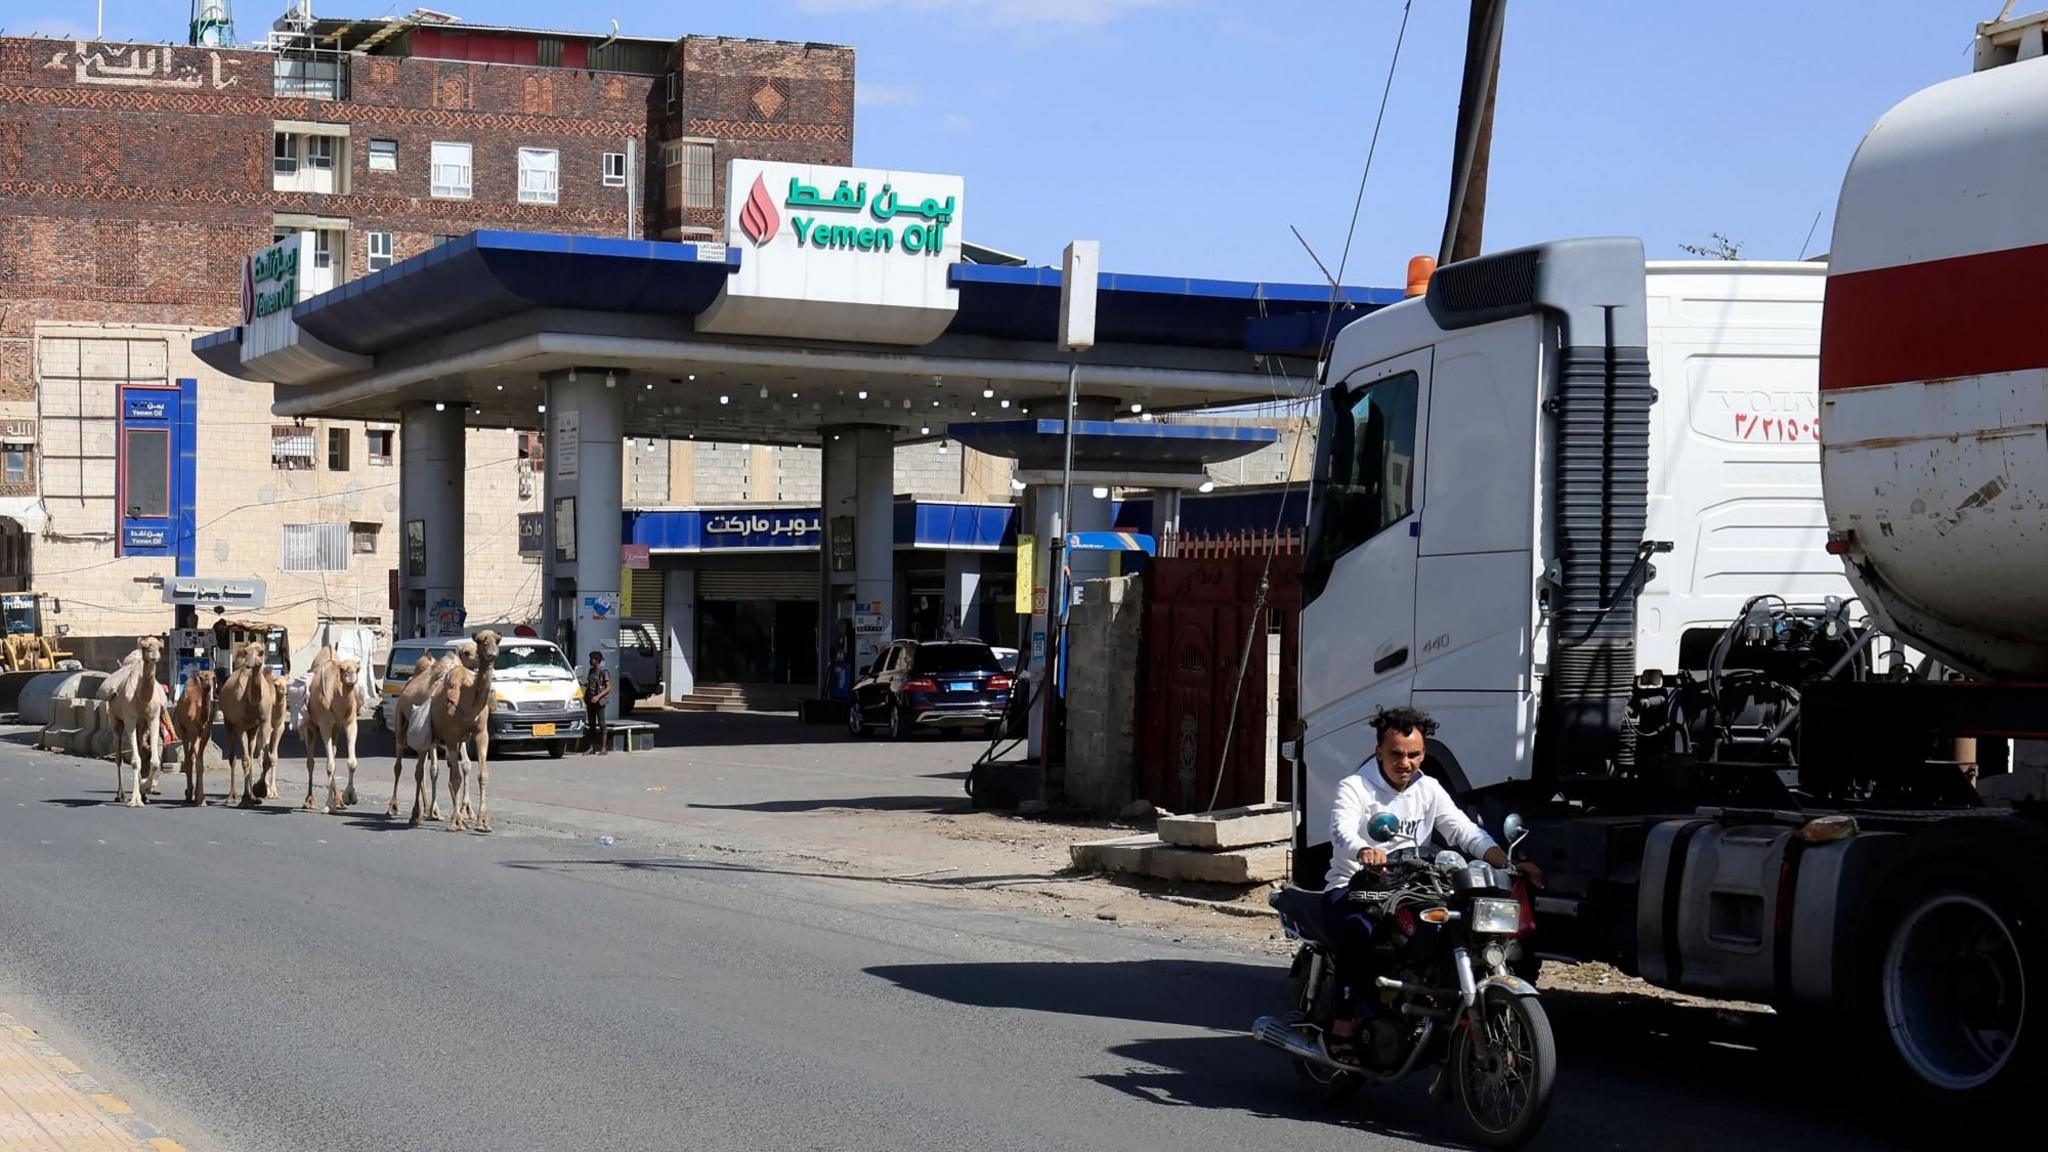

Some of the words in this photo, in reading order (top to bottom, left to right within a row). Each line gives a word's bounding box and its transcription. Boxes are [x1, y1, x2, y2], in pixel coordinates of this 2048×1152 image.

[785, 177, 867, 212] نفط
[870, 183, 955, 222] يمن
[792, 216, 894, 251] Yemen
[902, 220, 944, 255] Oil
[255, 290, 281, 318] Yemen
[280, 277, 295, 309] Oil
[1707, 390, 1819, 412] VOLV
[706, 515, 769, 536] ماركت
[1422, 633, 1450, 651] 440
